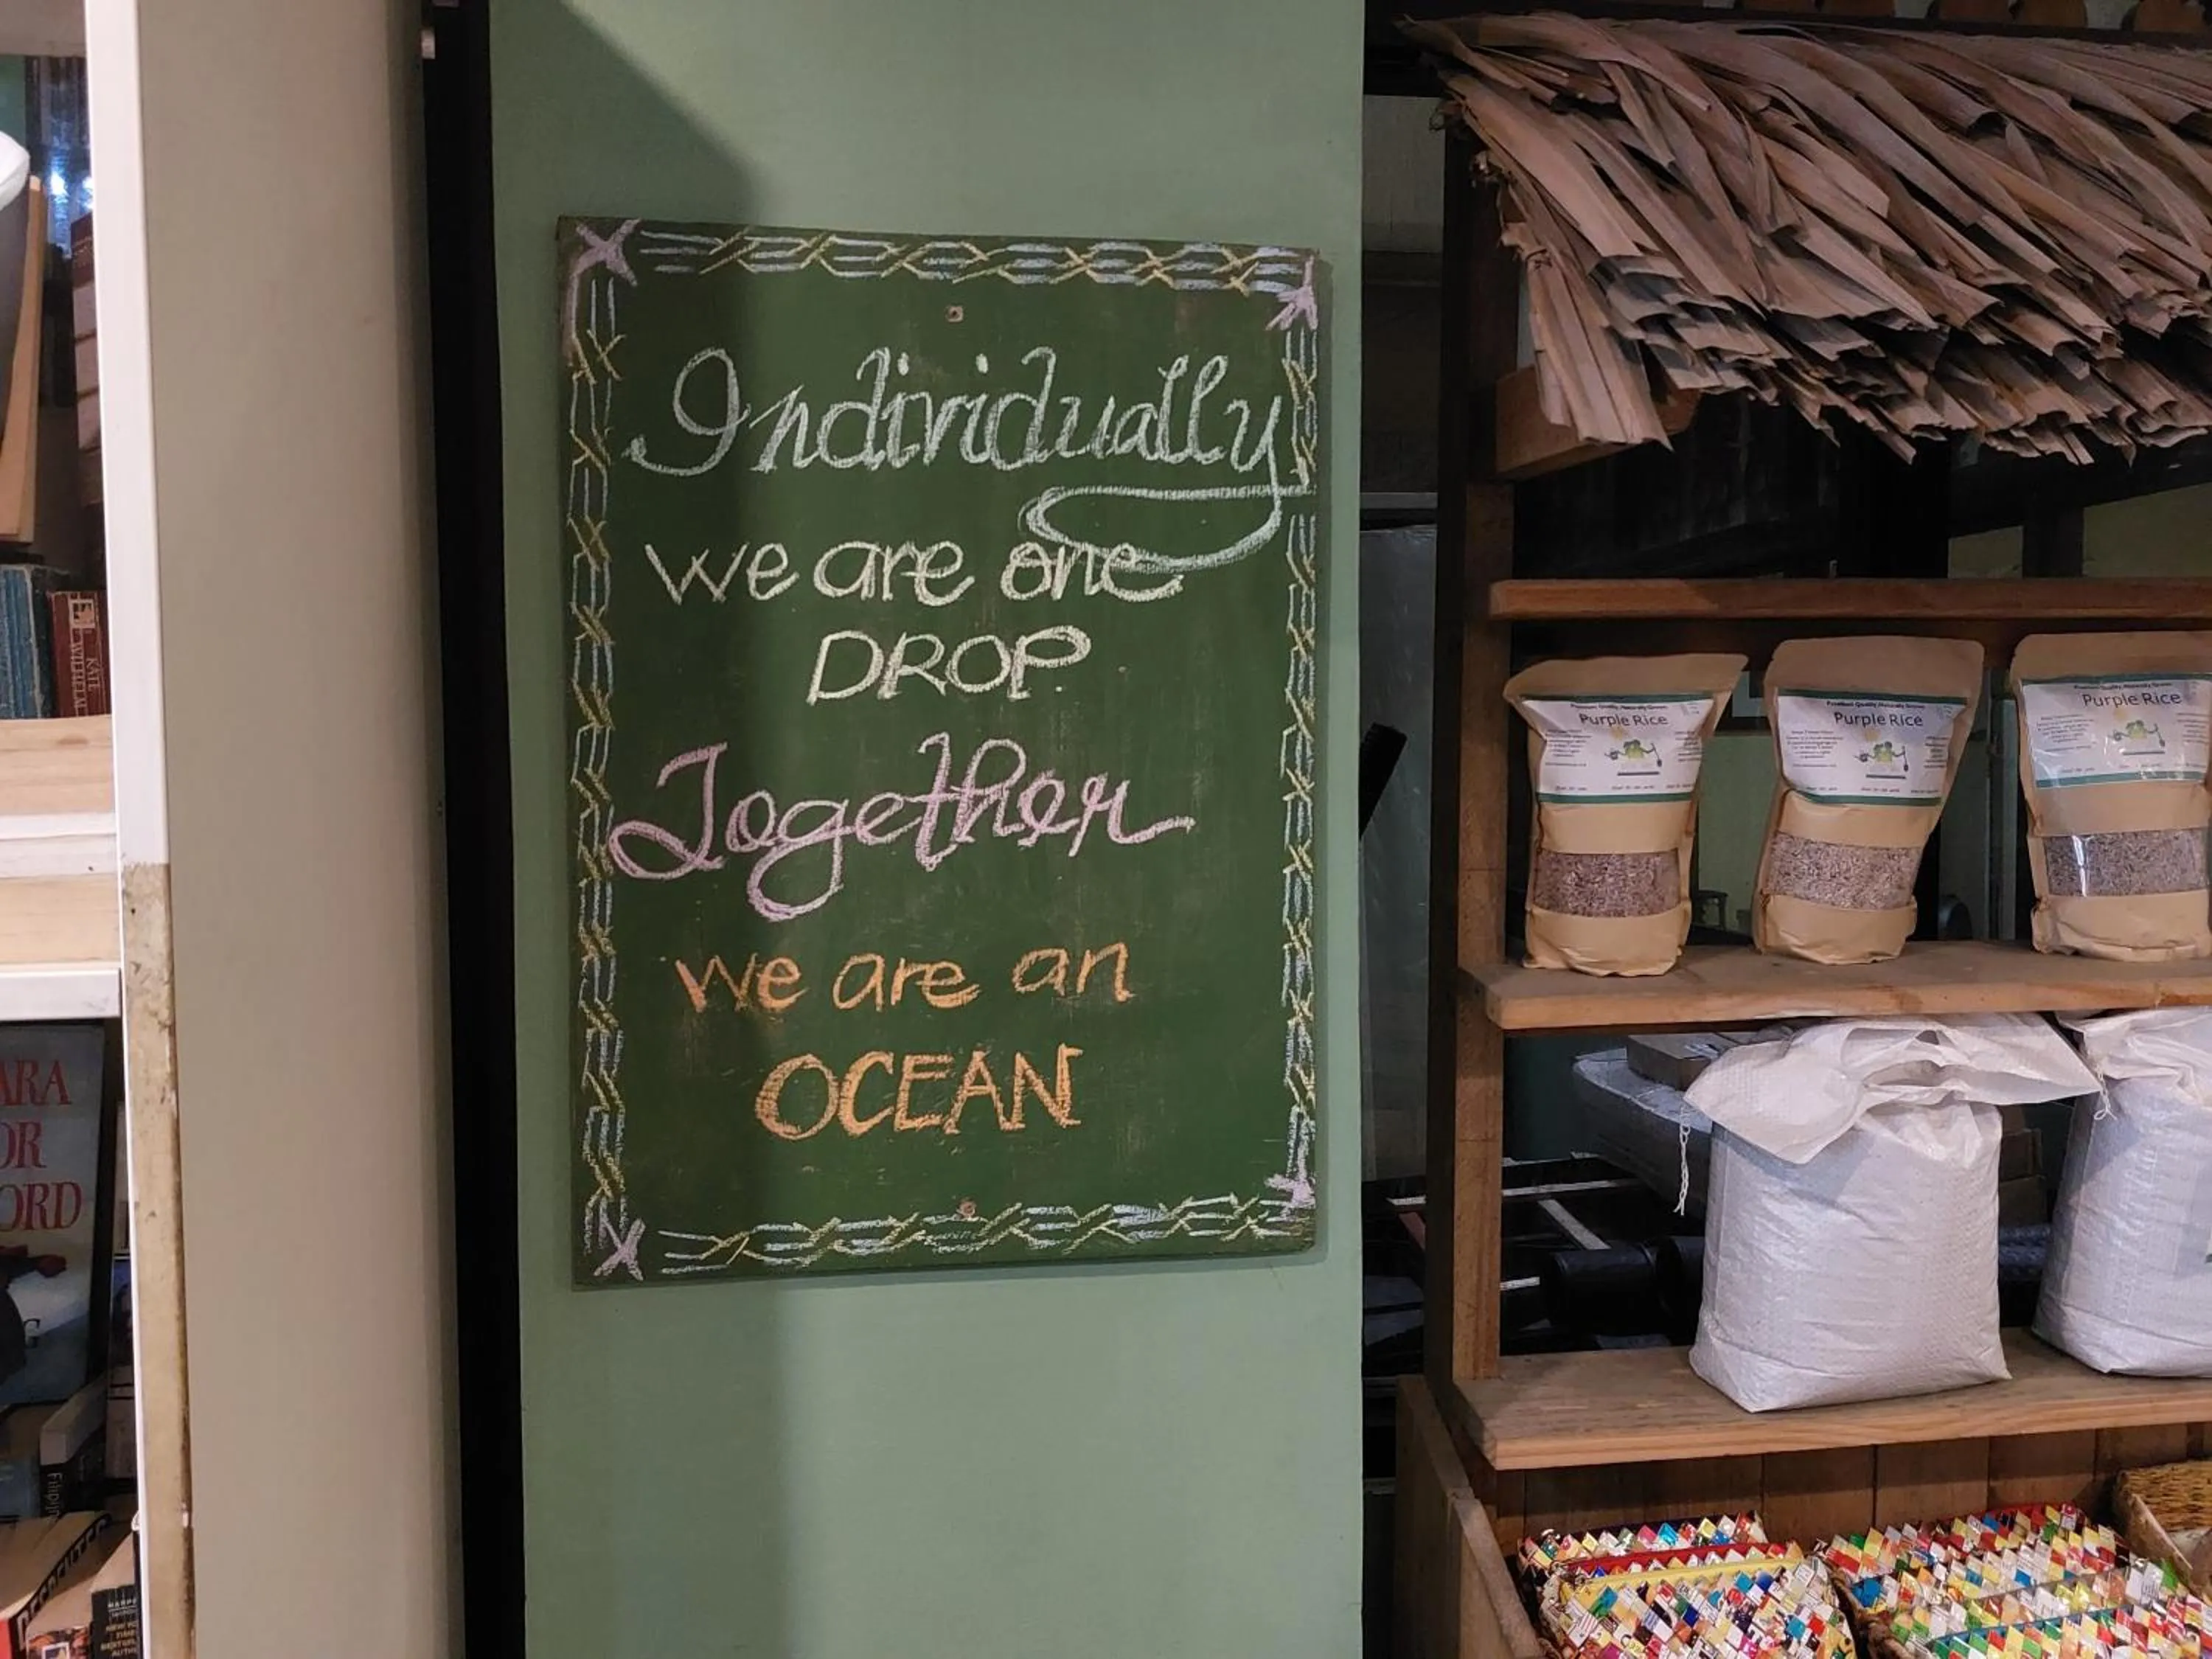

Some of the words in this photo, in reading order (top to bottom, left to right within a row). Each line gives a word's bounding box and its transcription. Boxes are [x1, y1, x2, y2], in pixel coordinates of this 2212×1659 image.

[622, 347, 1314, 574] Individually
[644, 542, 800, 605] we
[813, 541, 975, 605] are
[1001, 542, 1183, 602] one
[807, 625, 1092, 706] DROP
[2081, 692, 2139, 709] Purple
[2141, 692, 2183, 706] Rice
[1579, 712, 1630, 727] Purple
[1633, 714, 1669, 726] Rice
[1834, 712, 1887, 728] Purple
[1889, 714, 1923, 726] Rice
[608, 732, 1197, 922] Together
[675, 953, 810, 1012] we
[832, 953, 981, 1012] are
[1012, 942, 1135, 1003] an
[755, 1043, 1083, 1141] OCEAN
